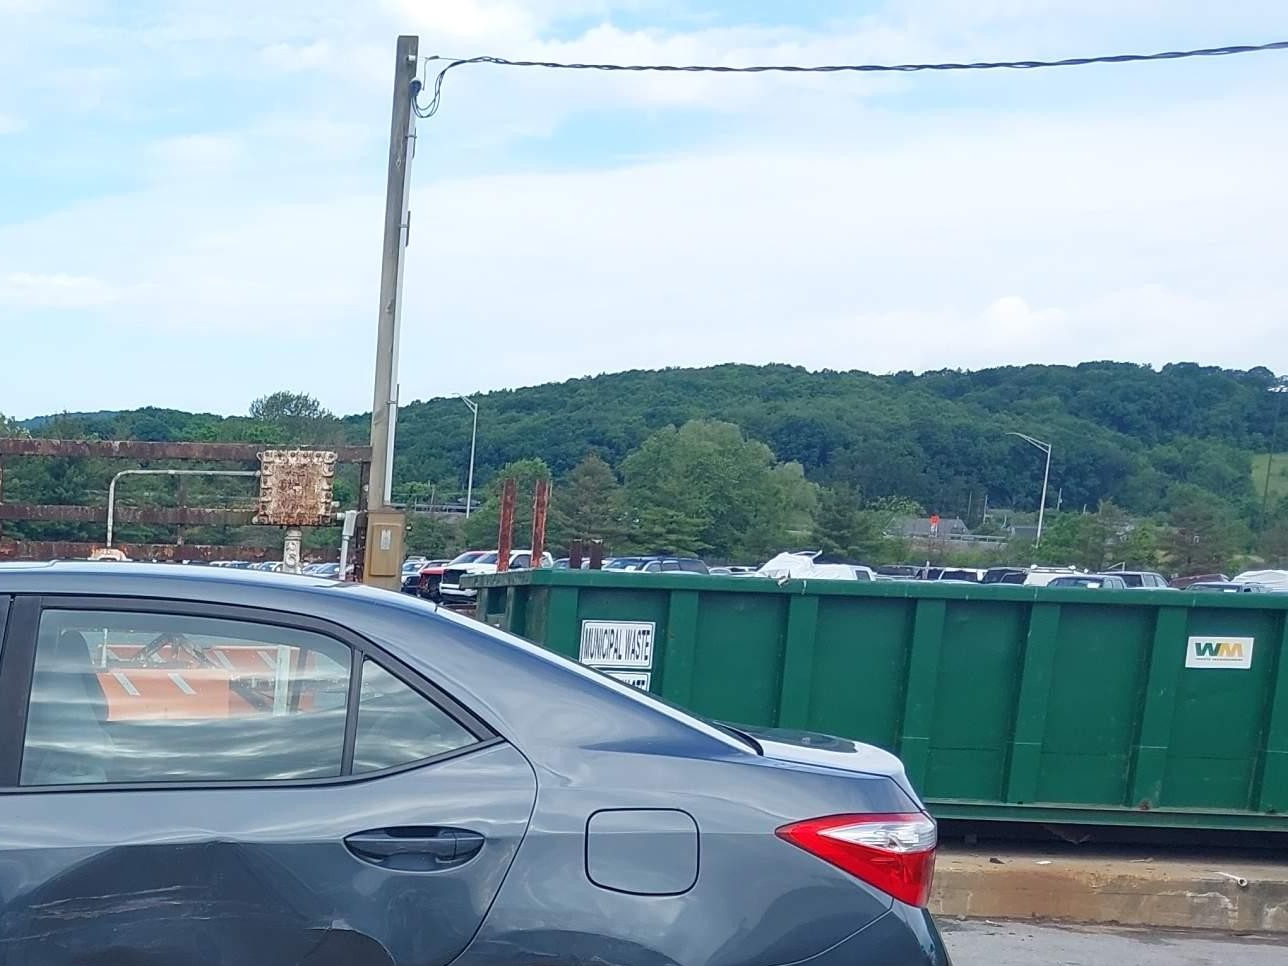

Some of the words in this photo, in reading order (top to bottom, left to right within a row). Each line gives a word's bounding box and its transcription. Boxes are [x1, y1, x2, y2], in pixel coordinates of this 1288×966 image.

[583, 627, 622, 660] MUNICIPAL
[624, 628, 650, 660] WASTE
[1195, 642, 1242, 656] WM
